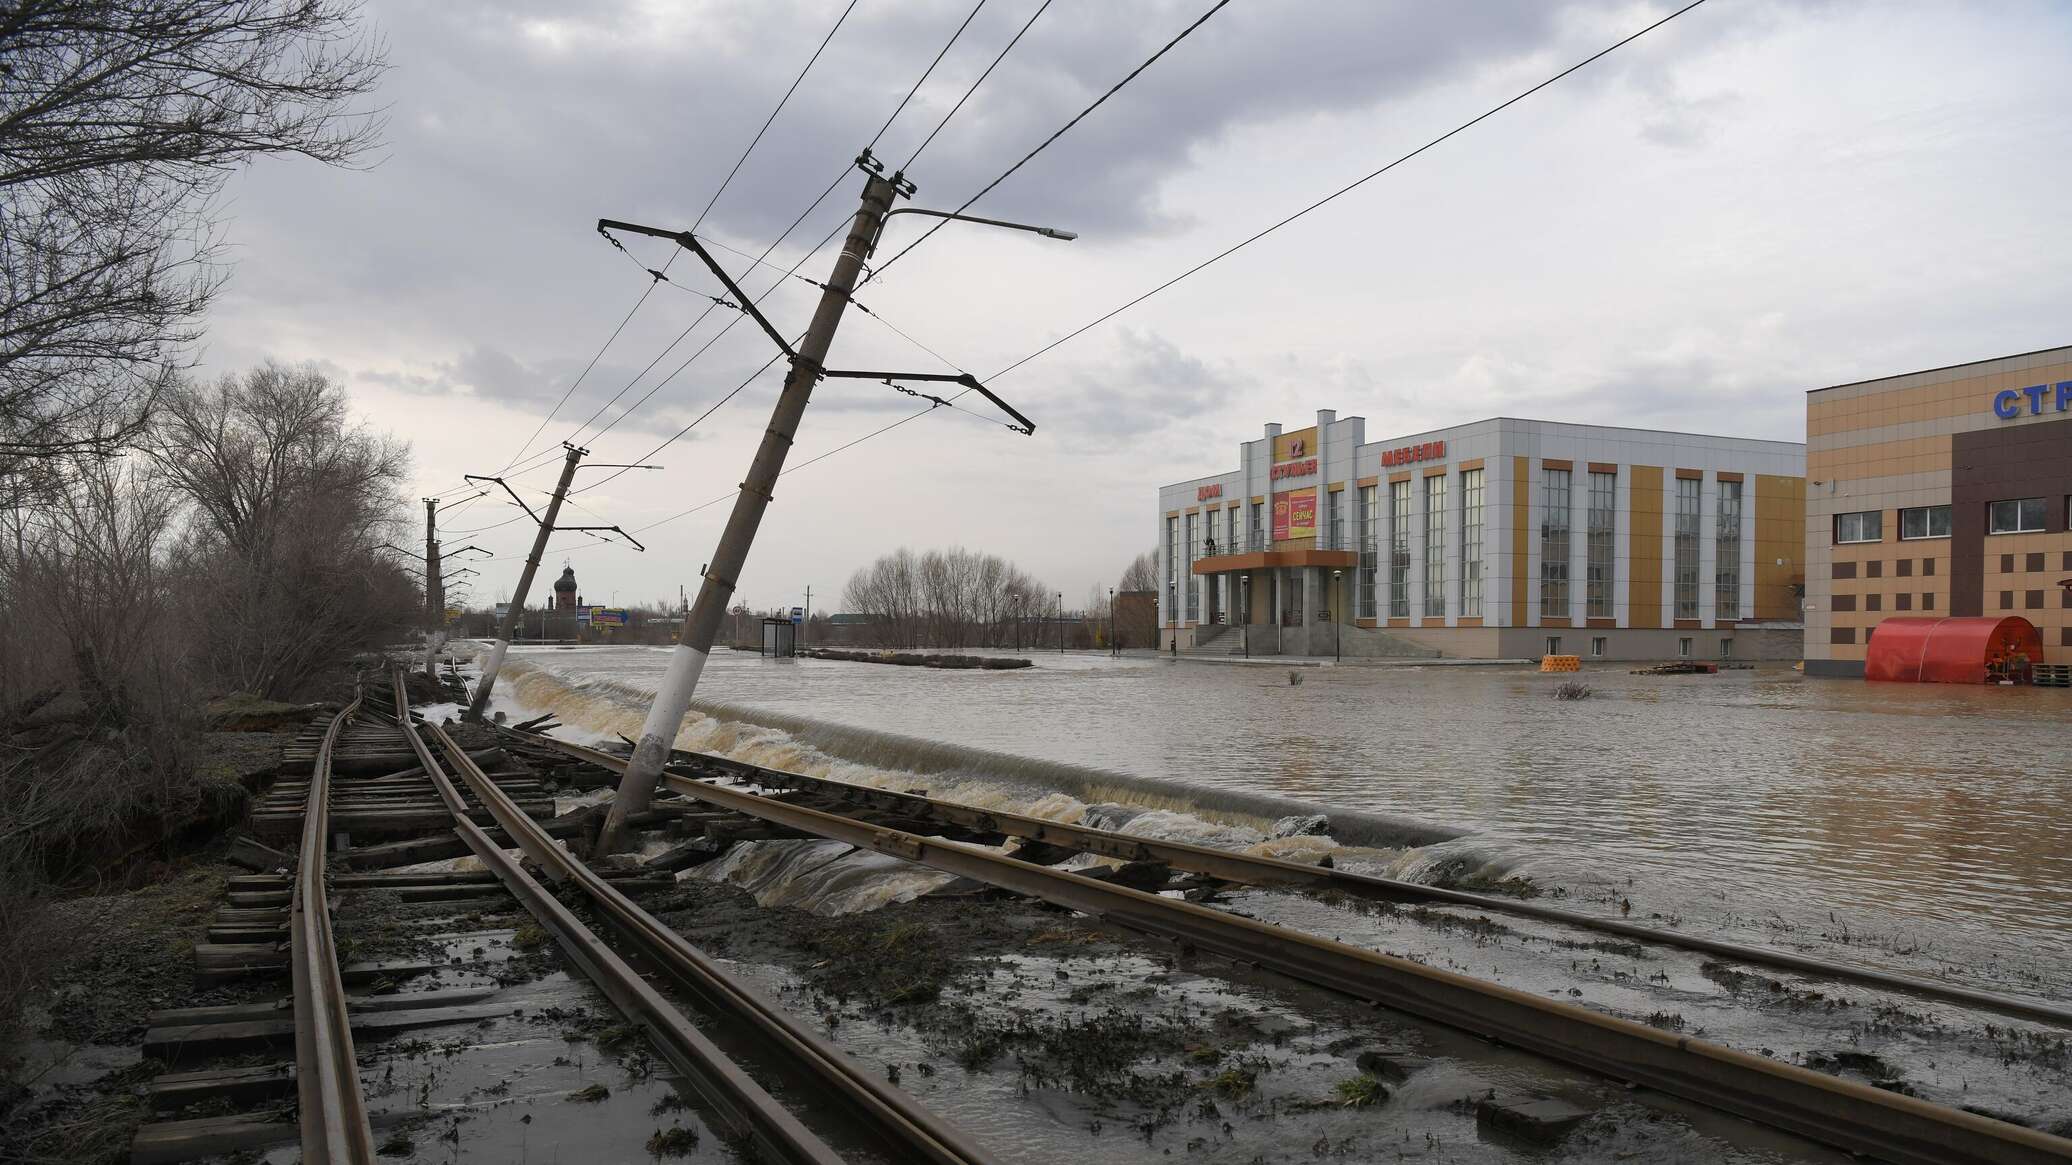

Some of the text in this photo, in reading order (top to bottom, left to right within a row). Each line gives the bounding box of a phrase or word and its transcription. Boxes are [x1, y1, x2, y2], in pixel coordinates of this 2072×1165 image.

[1288, 440, 1303, 456] 12
[1381, 441, 1445, 466] МЕБЕЛИ
[1270, 458, 1318, 479] СТУЛЬЕВ
